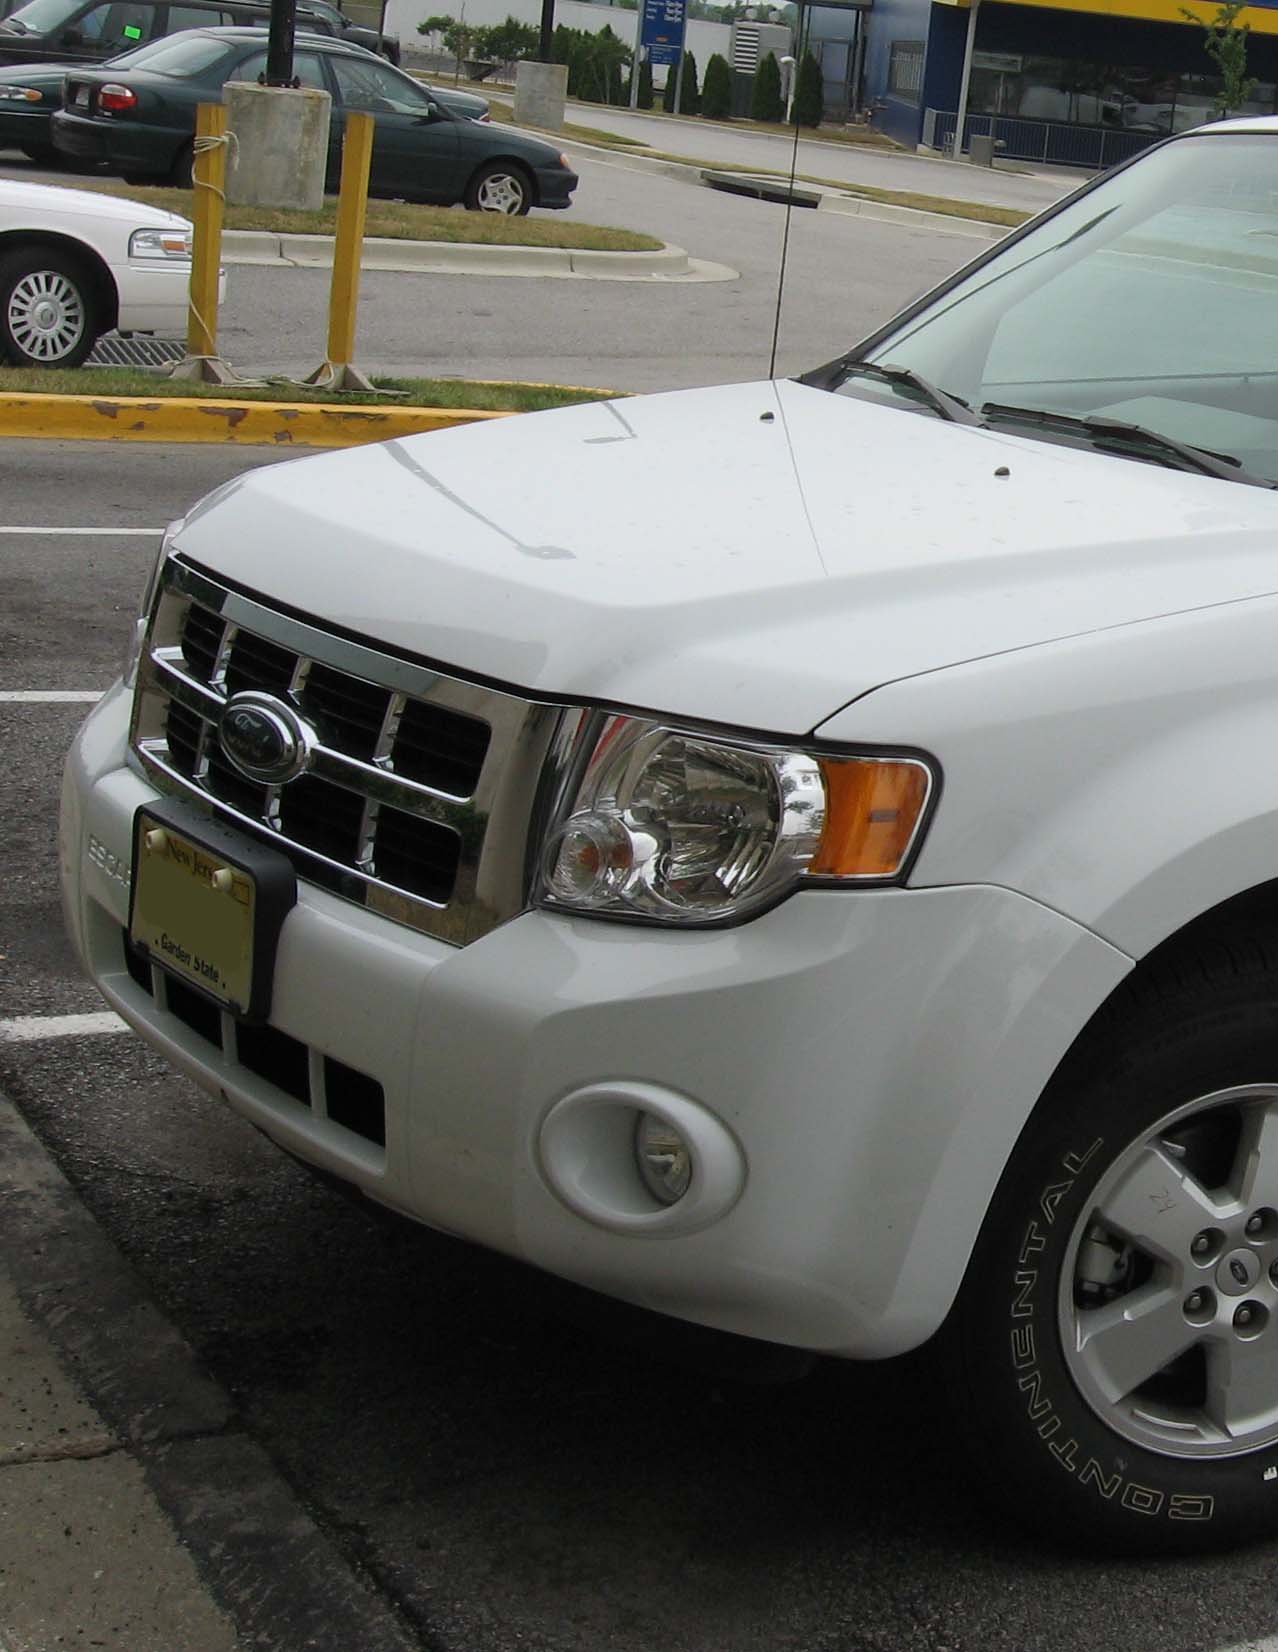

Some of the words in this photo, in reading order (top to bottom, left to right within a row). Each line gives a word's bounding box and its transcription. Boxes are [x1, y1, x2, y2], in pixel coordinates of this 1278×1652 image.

[160, 932, 192, 967] Garden
[193, 956, 220, 984] State
[1010, 1136, 1215, 1521] CONTINENTAL
